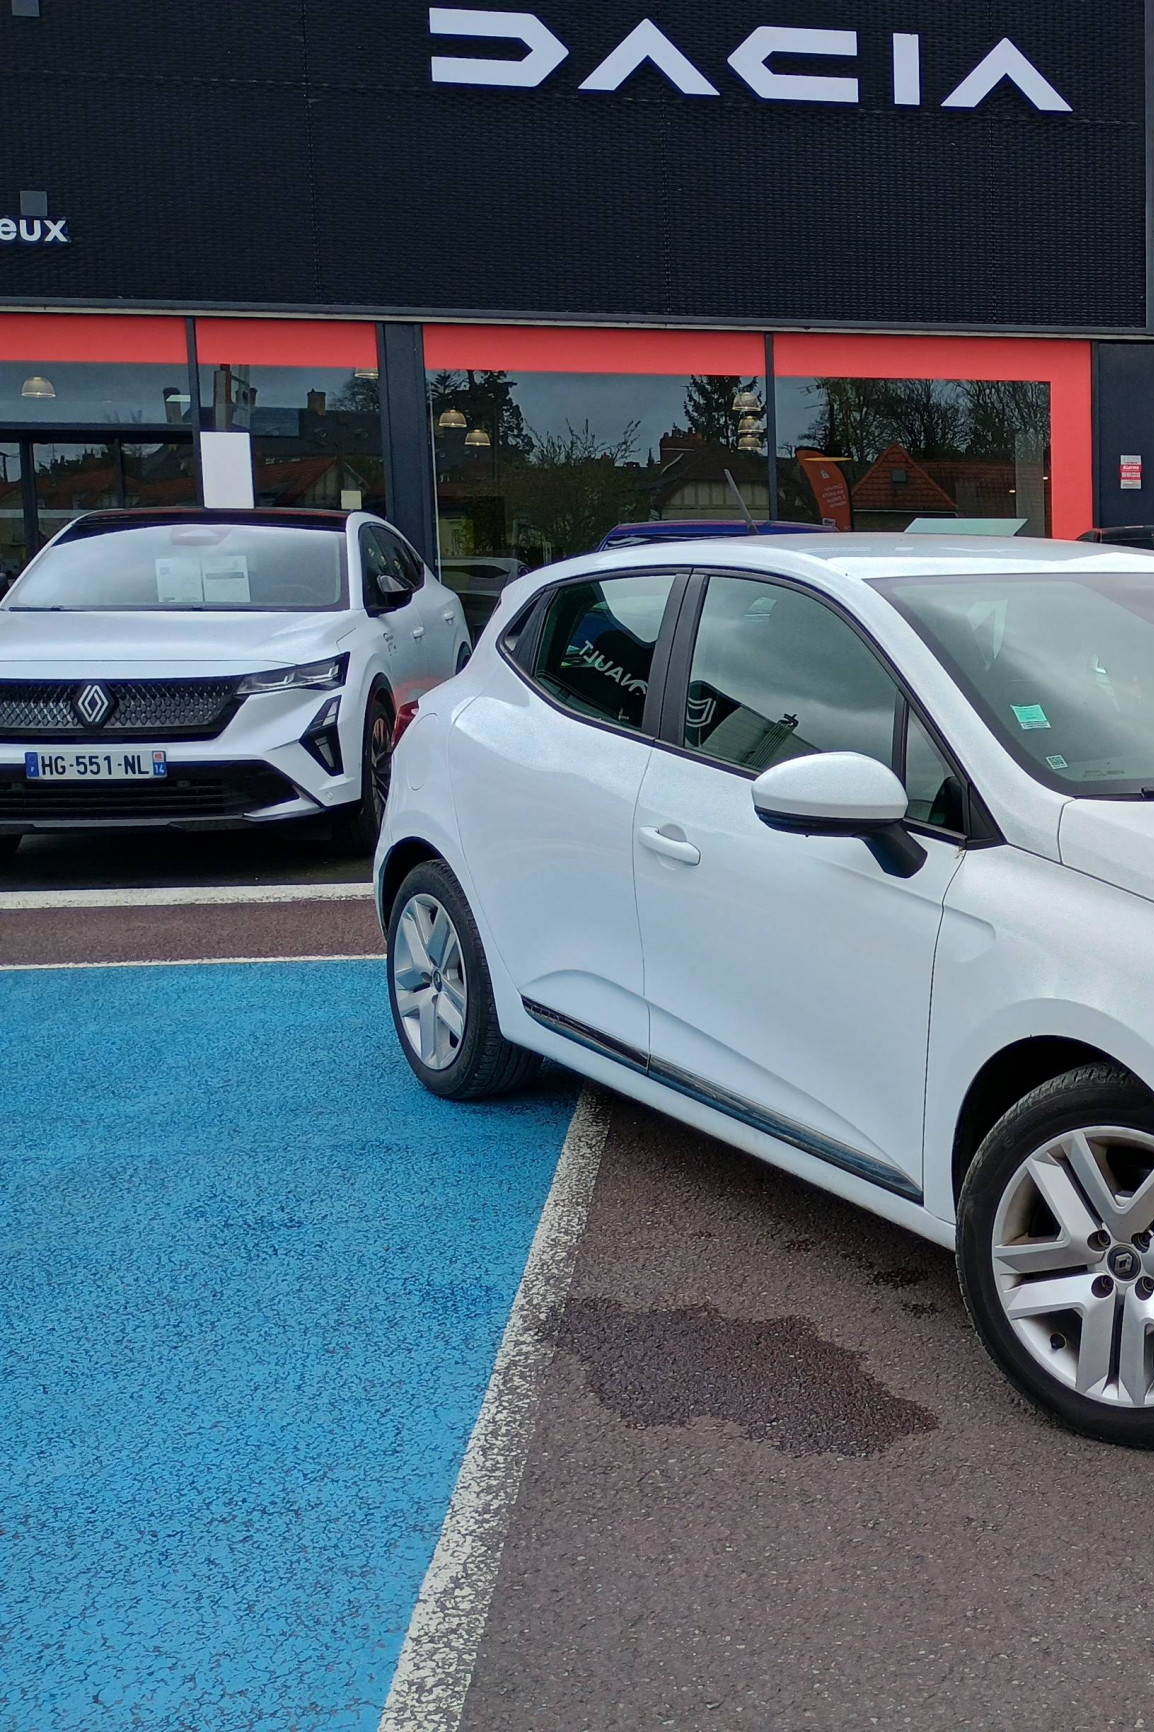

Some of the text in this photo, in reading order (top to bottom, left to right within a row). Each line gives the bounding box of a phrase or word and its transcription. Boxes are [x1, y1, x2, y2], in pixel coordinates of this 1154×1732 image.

[429, 7, 1073, 112] DACIA
[40, 755, 149, 775] HG-551-NL
[154, 764, 165, 774] 14
